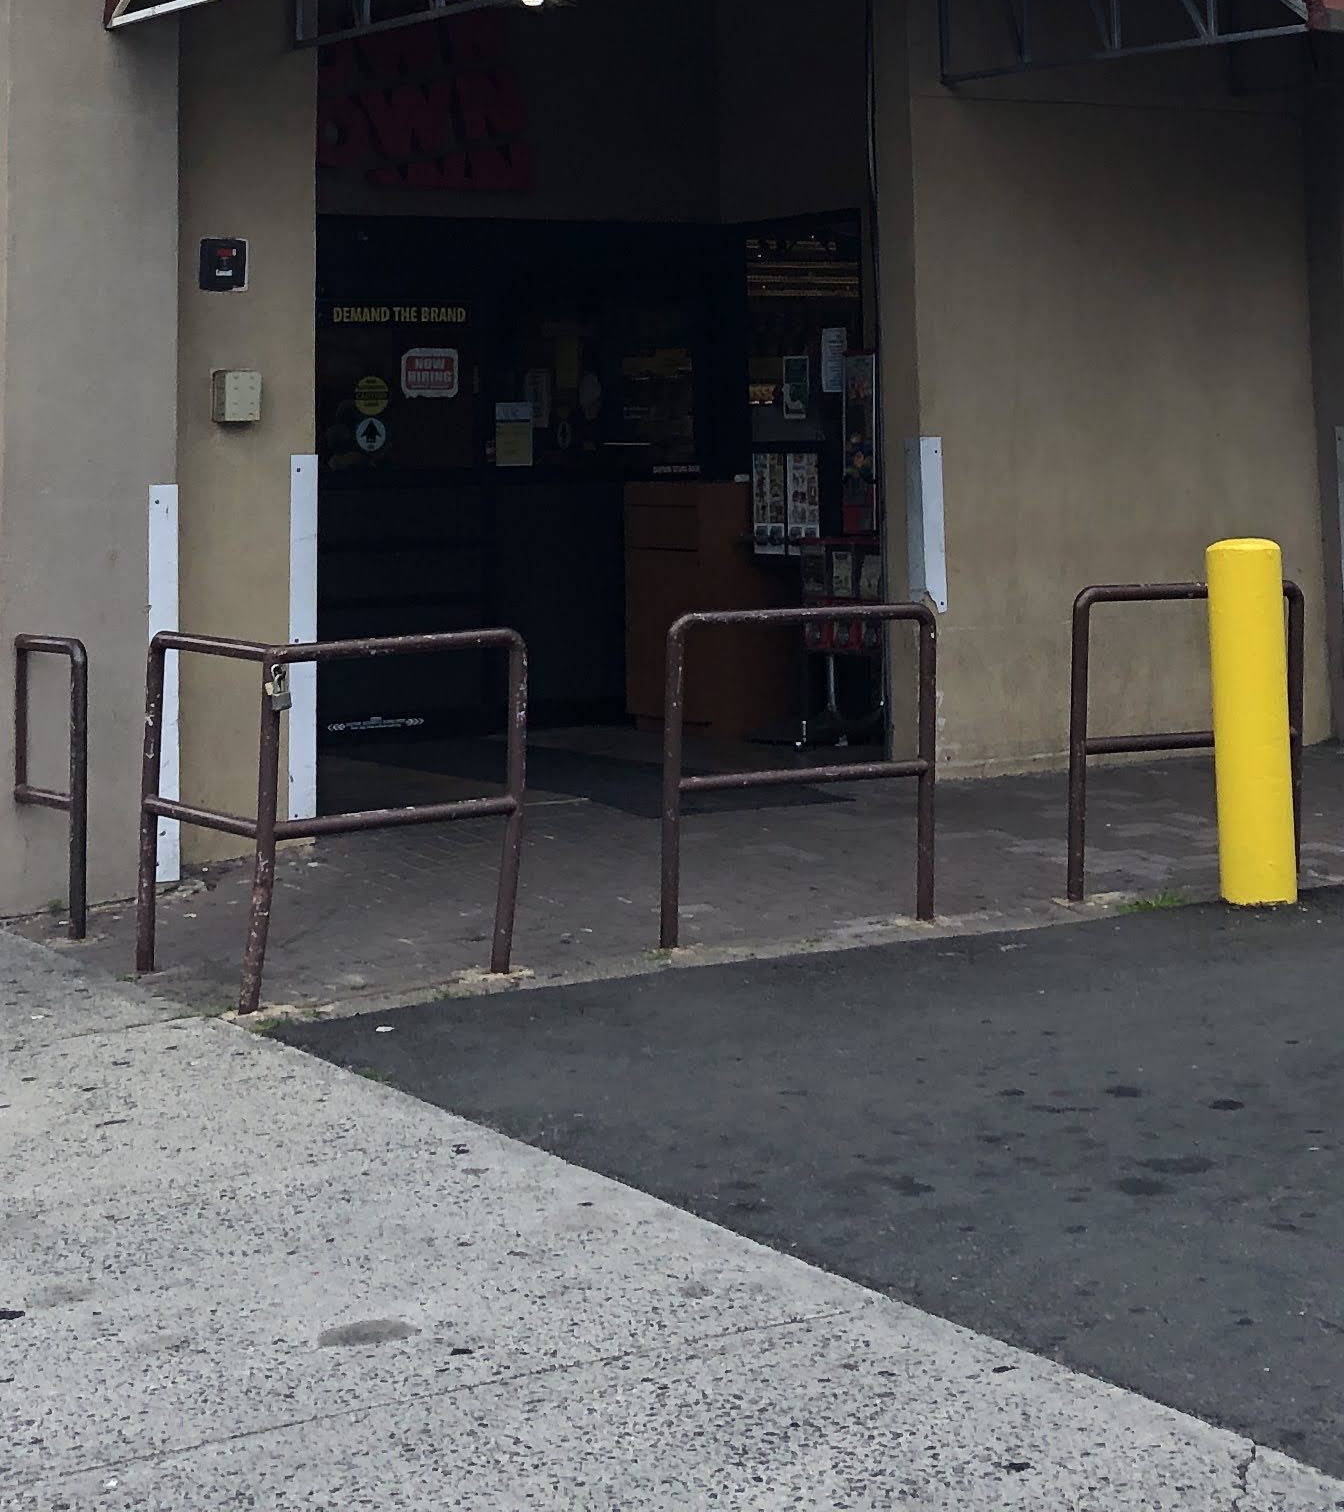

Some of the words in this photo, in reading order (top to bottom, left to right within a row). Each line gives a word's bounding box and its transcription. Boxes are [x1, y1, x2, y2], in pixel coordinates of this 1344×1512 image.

[333, 307, 390, 322] DEMAND
[393, 307, 418, 322] THE
[421, 307, 466, 322] BRAND
[414, 358, 445, 370] NOW
[407, 371, 453, 384] HIRING
